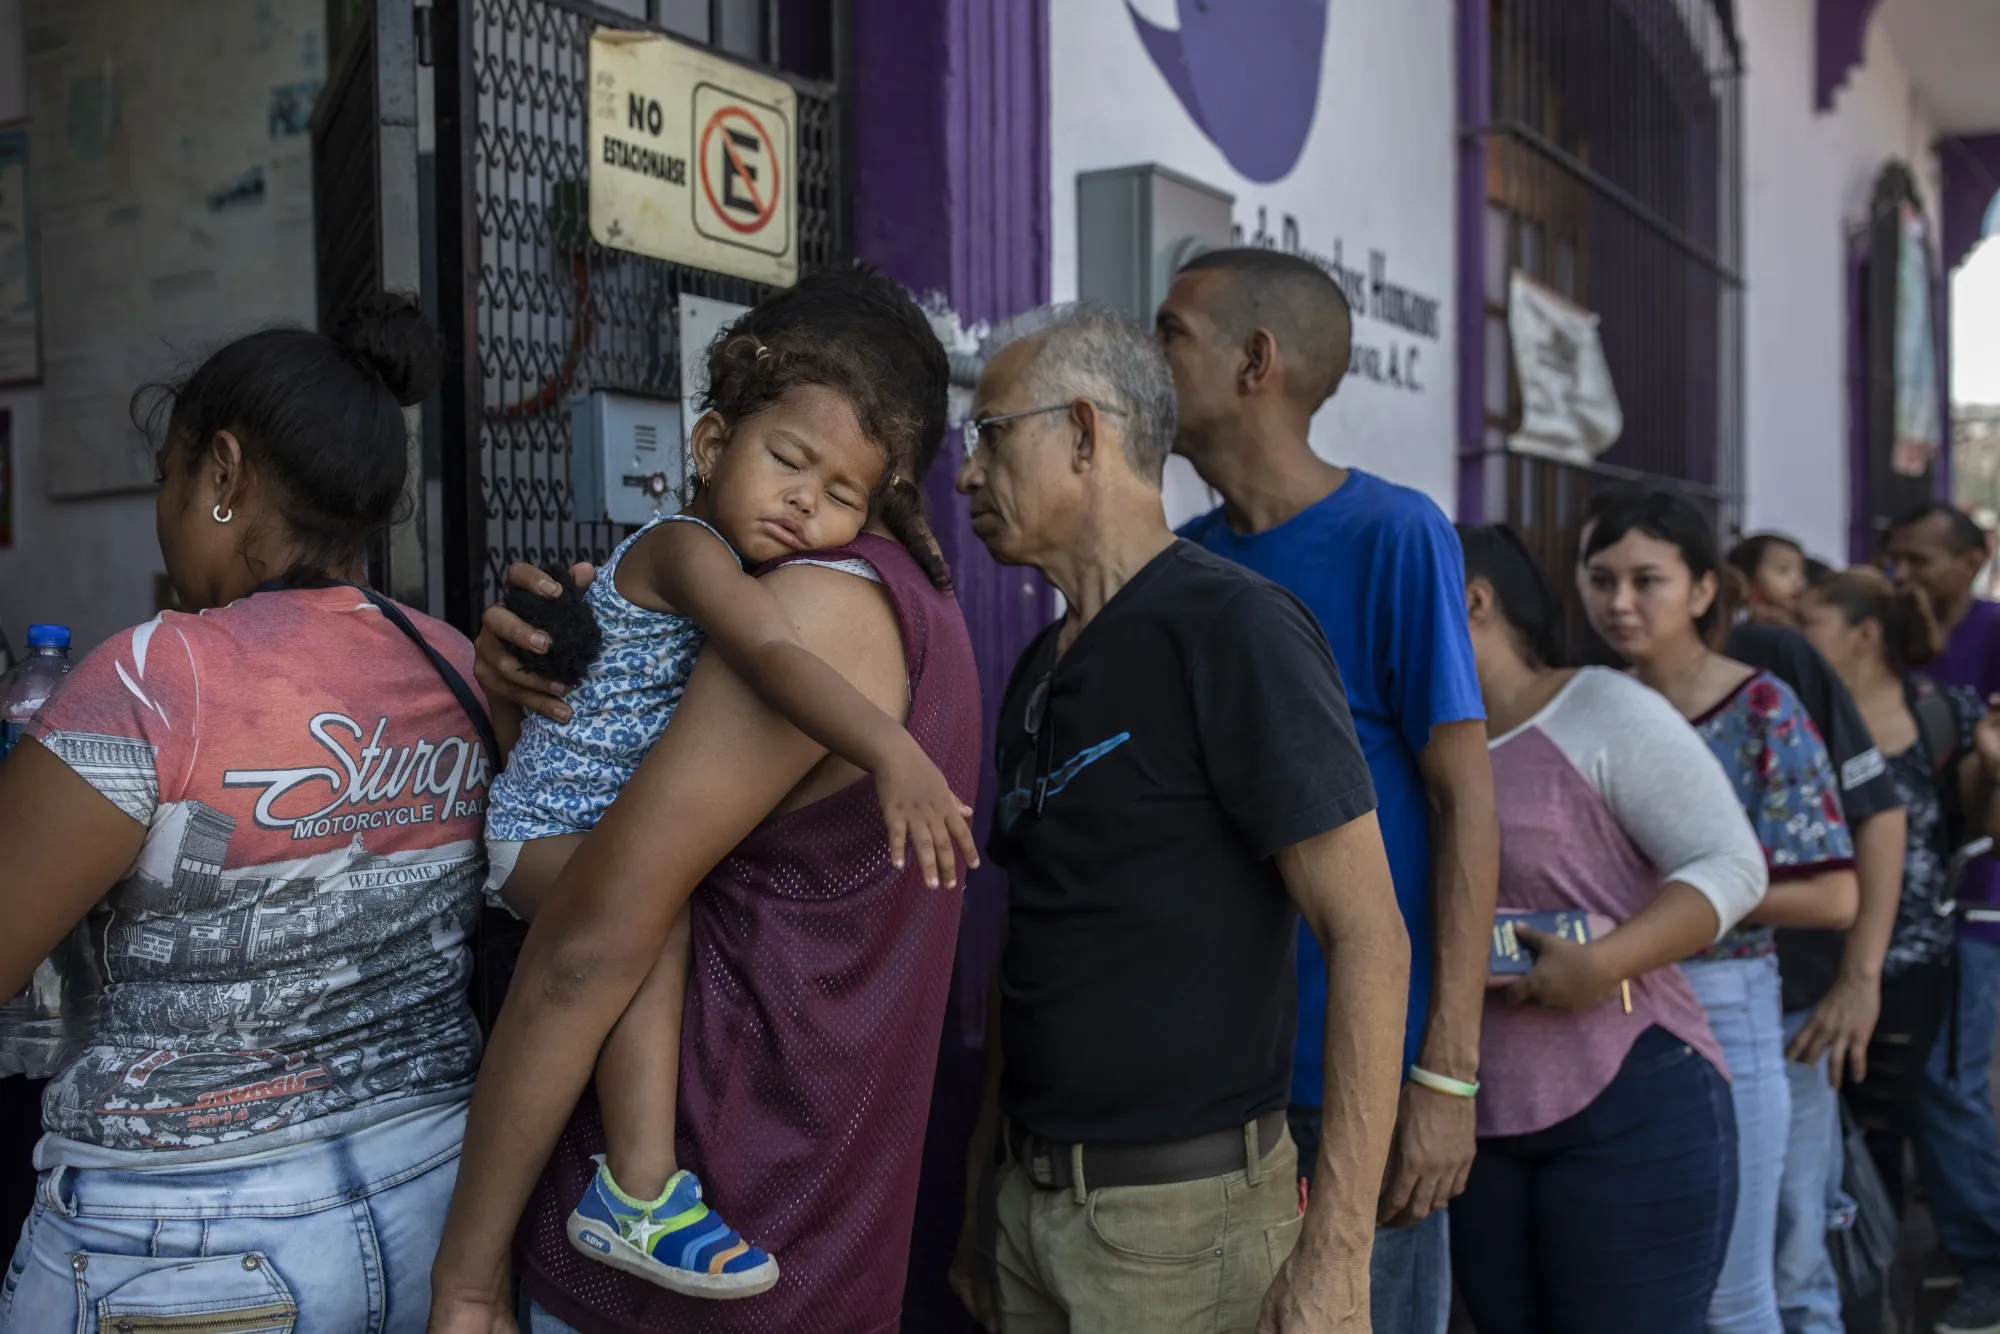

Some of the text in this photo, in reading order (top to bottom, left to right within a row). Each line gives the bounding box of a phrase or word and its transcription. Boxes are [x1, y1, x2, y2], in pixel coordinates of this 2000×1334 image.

[629, 90, 663, 138] NO
[603, 135, 686, 187] ESTACIONARSE
[291, 798, 485, 840] MOTORCYCLE RAL
[350, 865, 436, 888] WELCOME
[167, 1099, 271, 1118] 74TH ANNUAL
[187, 1107, 249, 1128] 2014
[156, 1120, 180, 1131] RALLY
[219, 1121, 246, 1132] BLACK
[246, 1111, 267, 1125] HILLS
